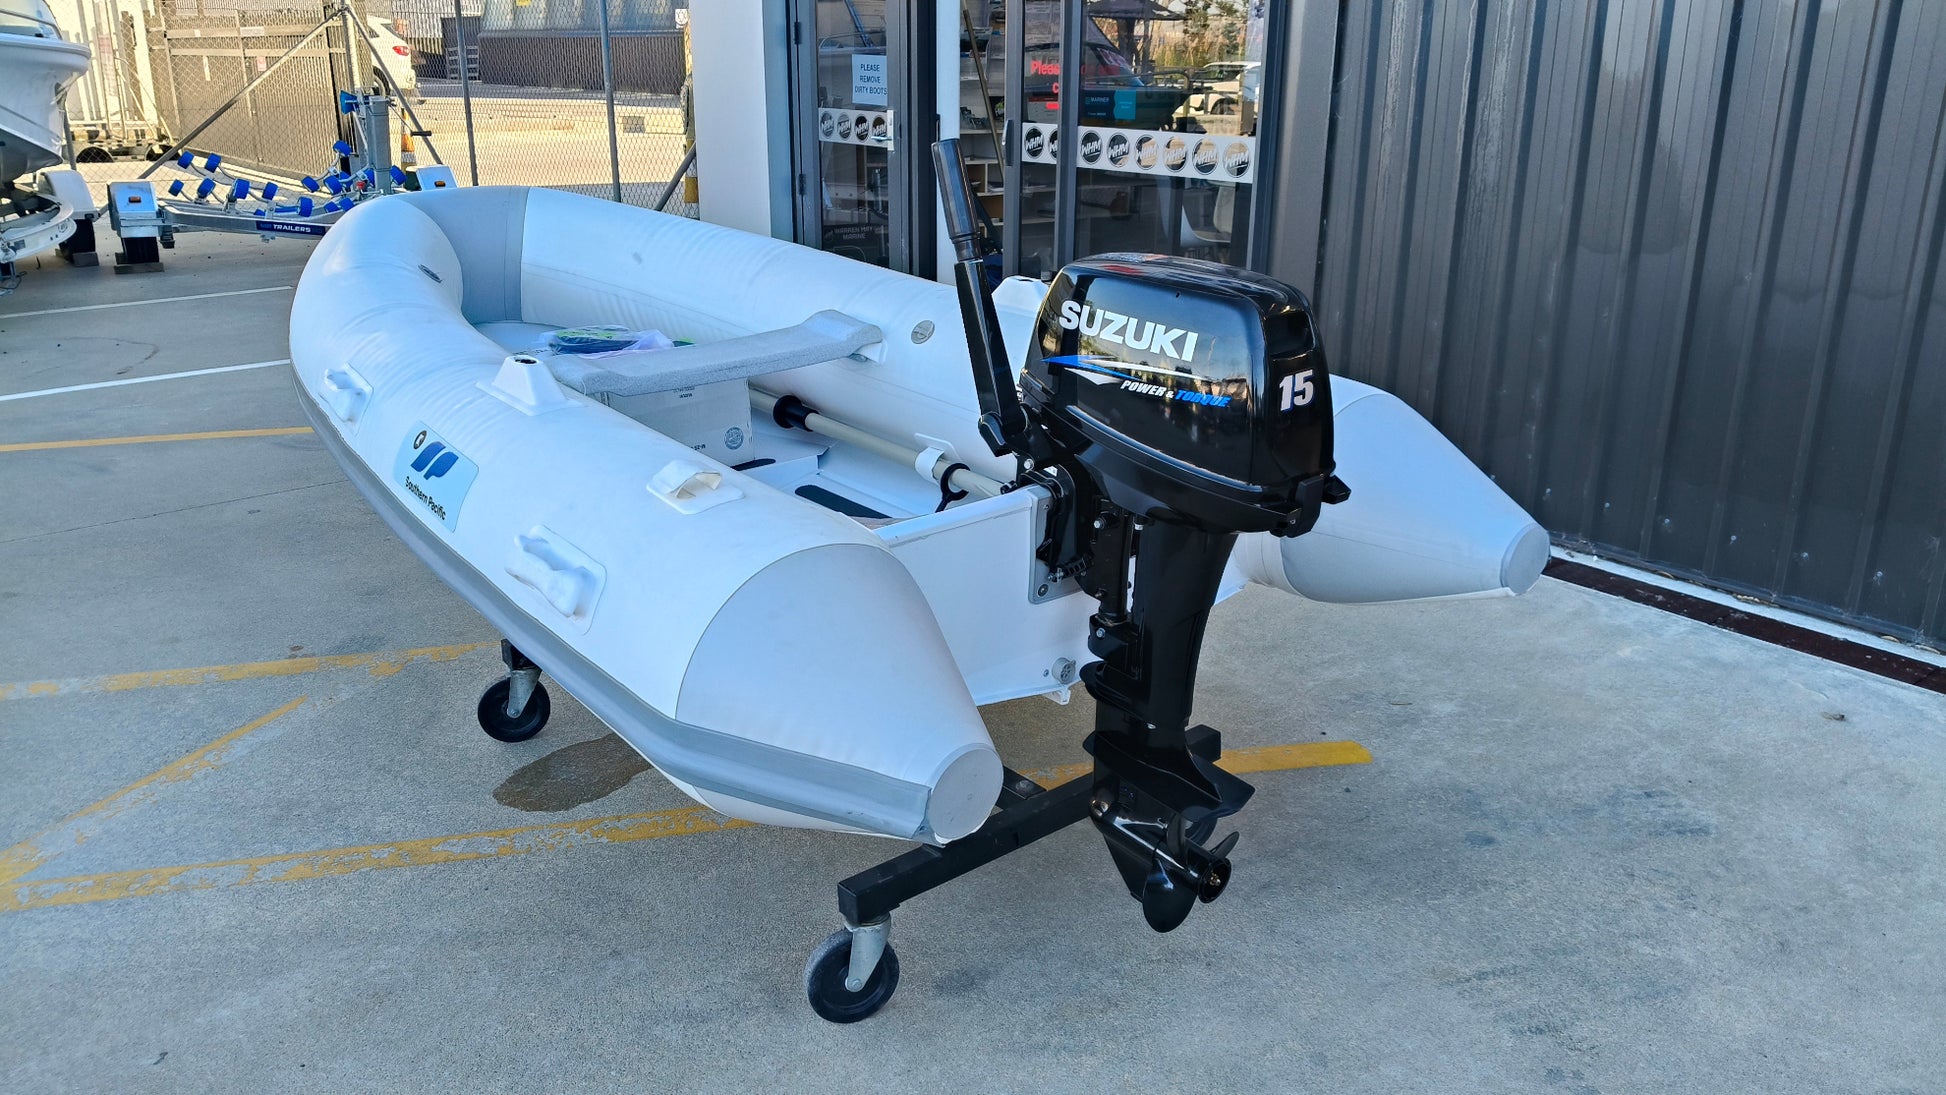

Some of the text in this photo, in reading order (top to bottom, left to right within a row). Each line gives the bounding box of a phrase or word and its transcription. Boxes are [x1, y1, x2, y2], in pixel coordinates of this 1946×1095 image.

[860, 63, 880, 72] PLEASE
[1031, 60, 1060, 75] Pleas
[859, 75, 881, 84] REMOVE
[854, 86, 888, 96] DIRTY BOOTS
[1025, 135, 1044, 151] WHM
[1081, 140, 1102, 157] WHM
[1109, 141, 1129, 158] WHM
[273, 223, 311, 233] TRAILERS
[1058, 300, 1199, 362] SUZUKI
[1120, 380, 1232, 408] POWER & TORQUE
[1279, 370, 1314, 412] 15
[405, 476, 446, 521] Southern Pacific
